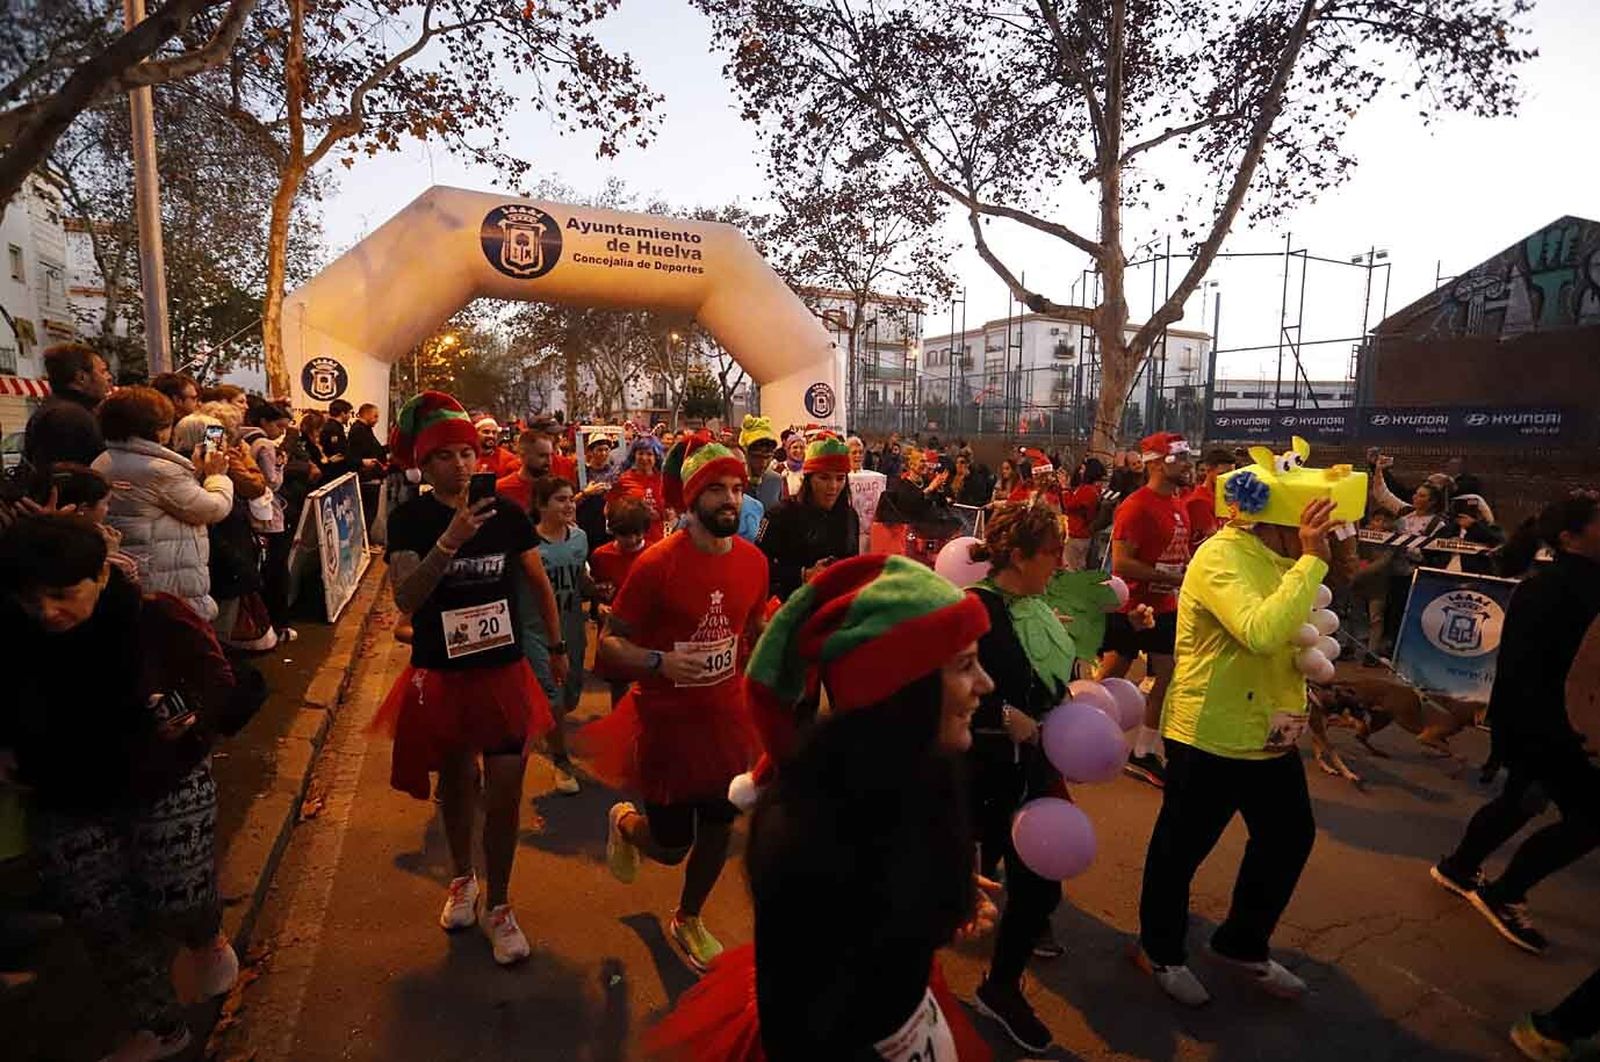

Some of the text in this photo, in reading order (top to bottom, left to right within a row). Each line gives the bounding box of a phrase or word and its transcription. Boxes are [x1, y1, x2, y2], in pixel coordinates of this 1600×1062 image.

[566, 217, 702, 243] Ayuntamiento
[607, 238, 702, 260] de Huelva
[637, 260, 651, 269] de
[654, 261, 704, 274] Deportes
[1230, 417, 1270, 426] HYUNDAI
[1299, 417, 1345, 426] HYUNDAI
[1392, 414, 1449, 425] HYUNDAI
[1491, 413, 1562, 425] HYUNDAI
[479, 617, 499, 637] 20
[702, 650, 732, 672] 403
